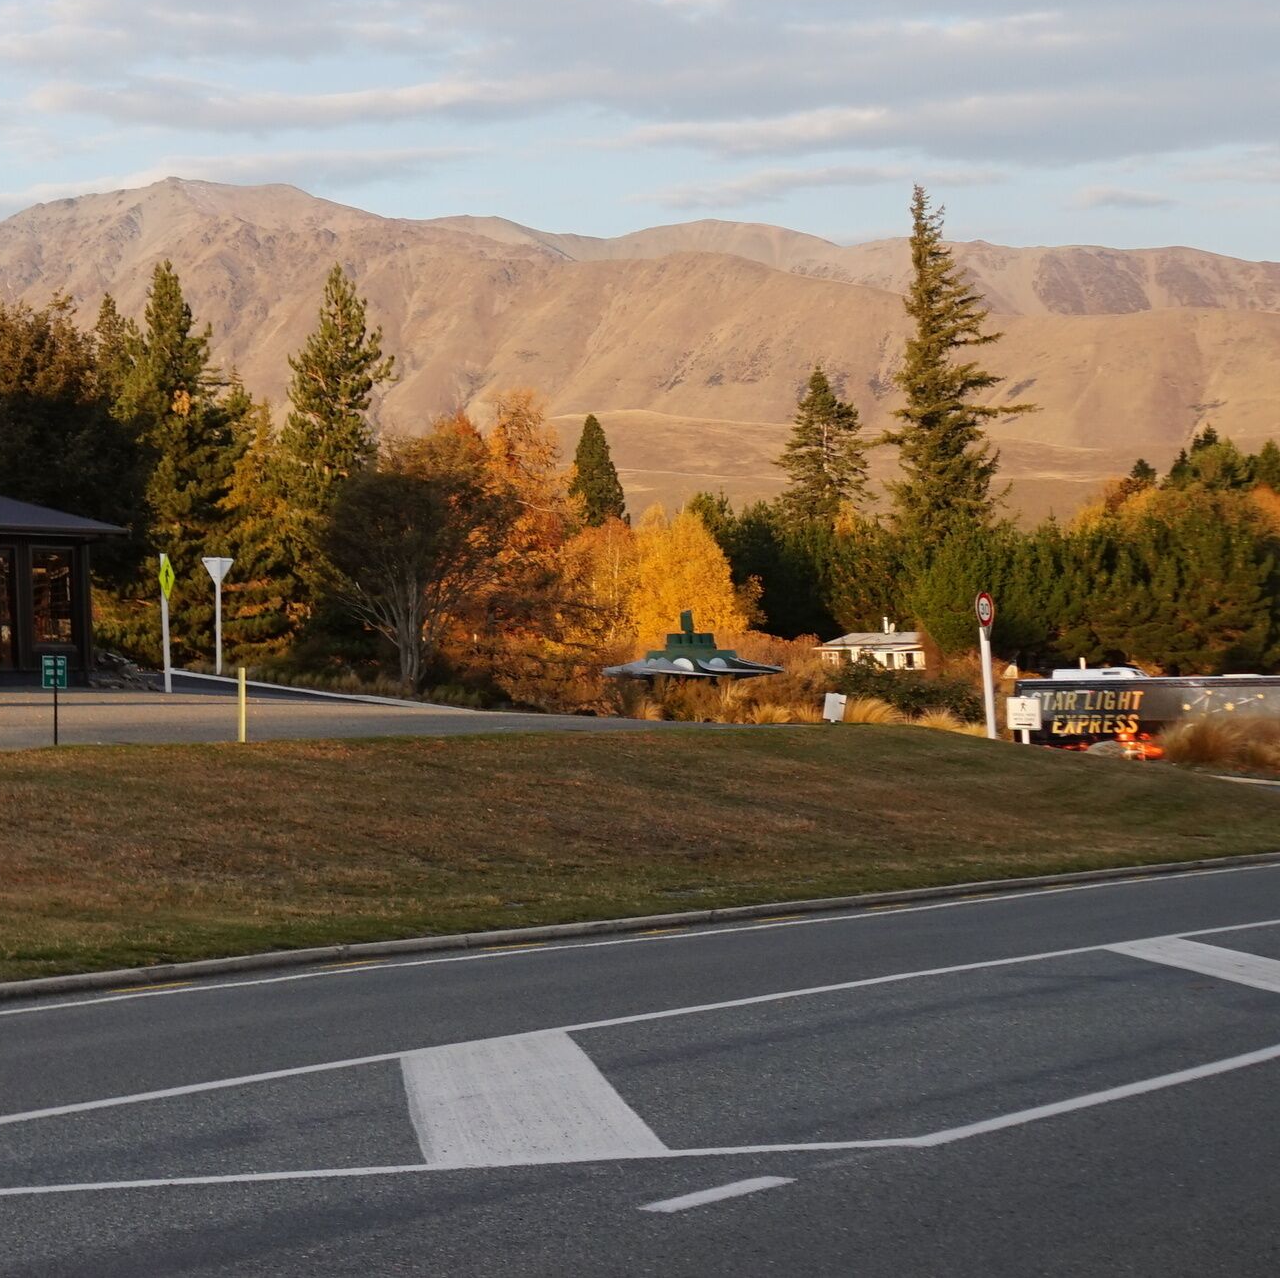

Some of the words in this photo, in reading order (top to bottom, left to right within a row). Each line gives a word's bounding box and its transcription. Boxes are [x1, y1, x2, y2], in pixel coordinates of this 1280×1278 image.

[980, 602, 990, 616] 30
[1085, 691, 1145, 711] LIGHT
[1052, 714, 1140, 734] EXPRESS
